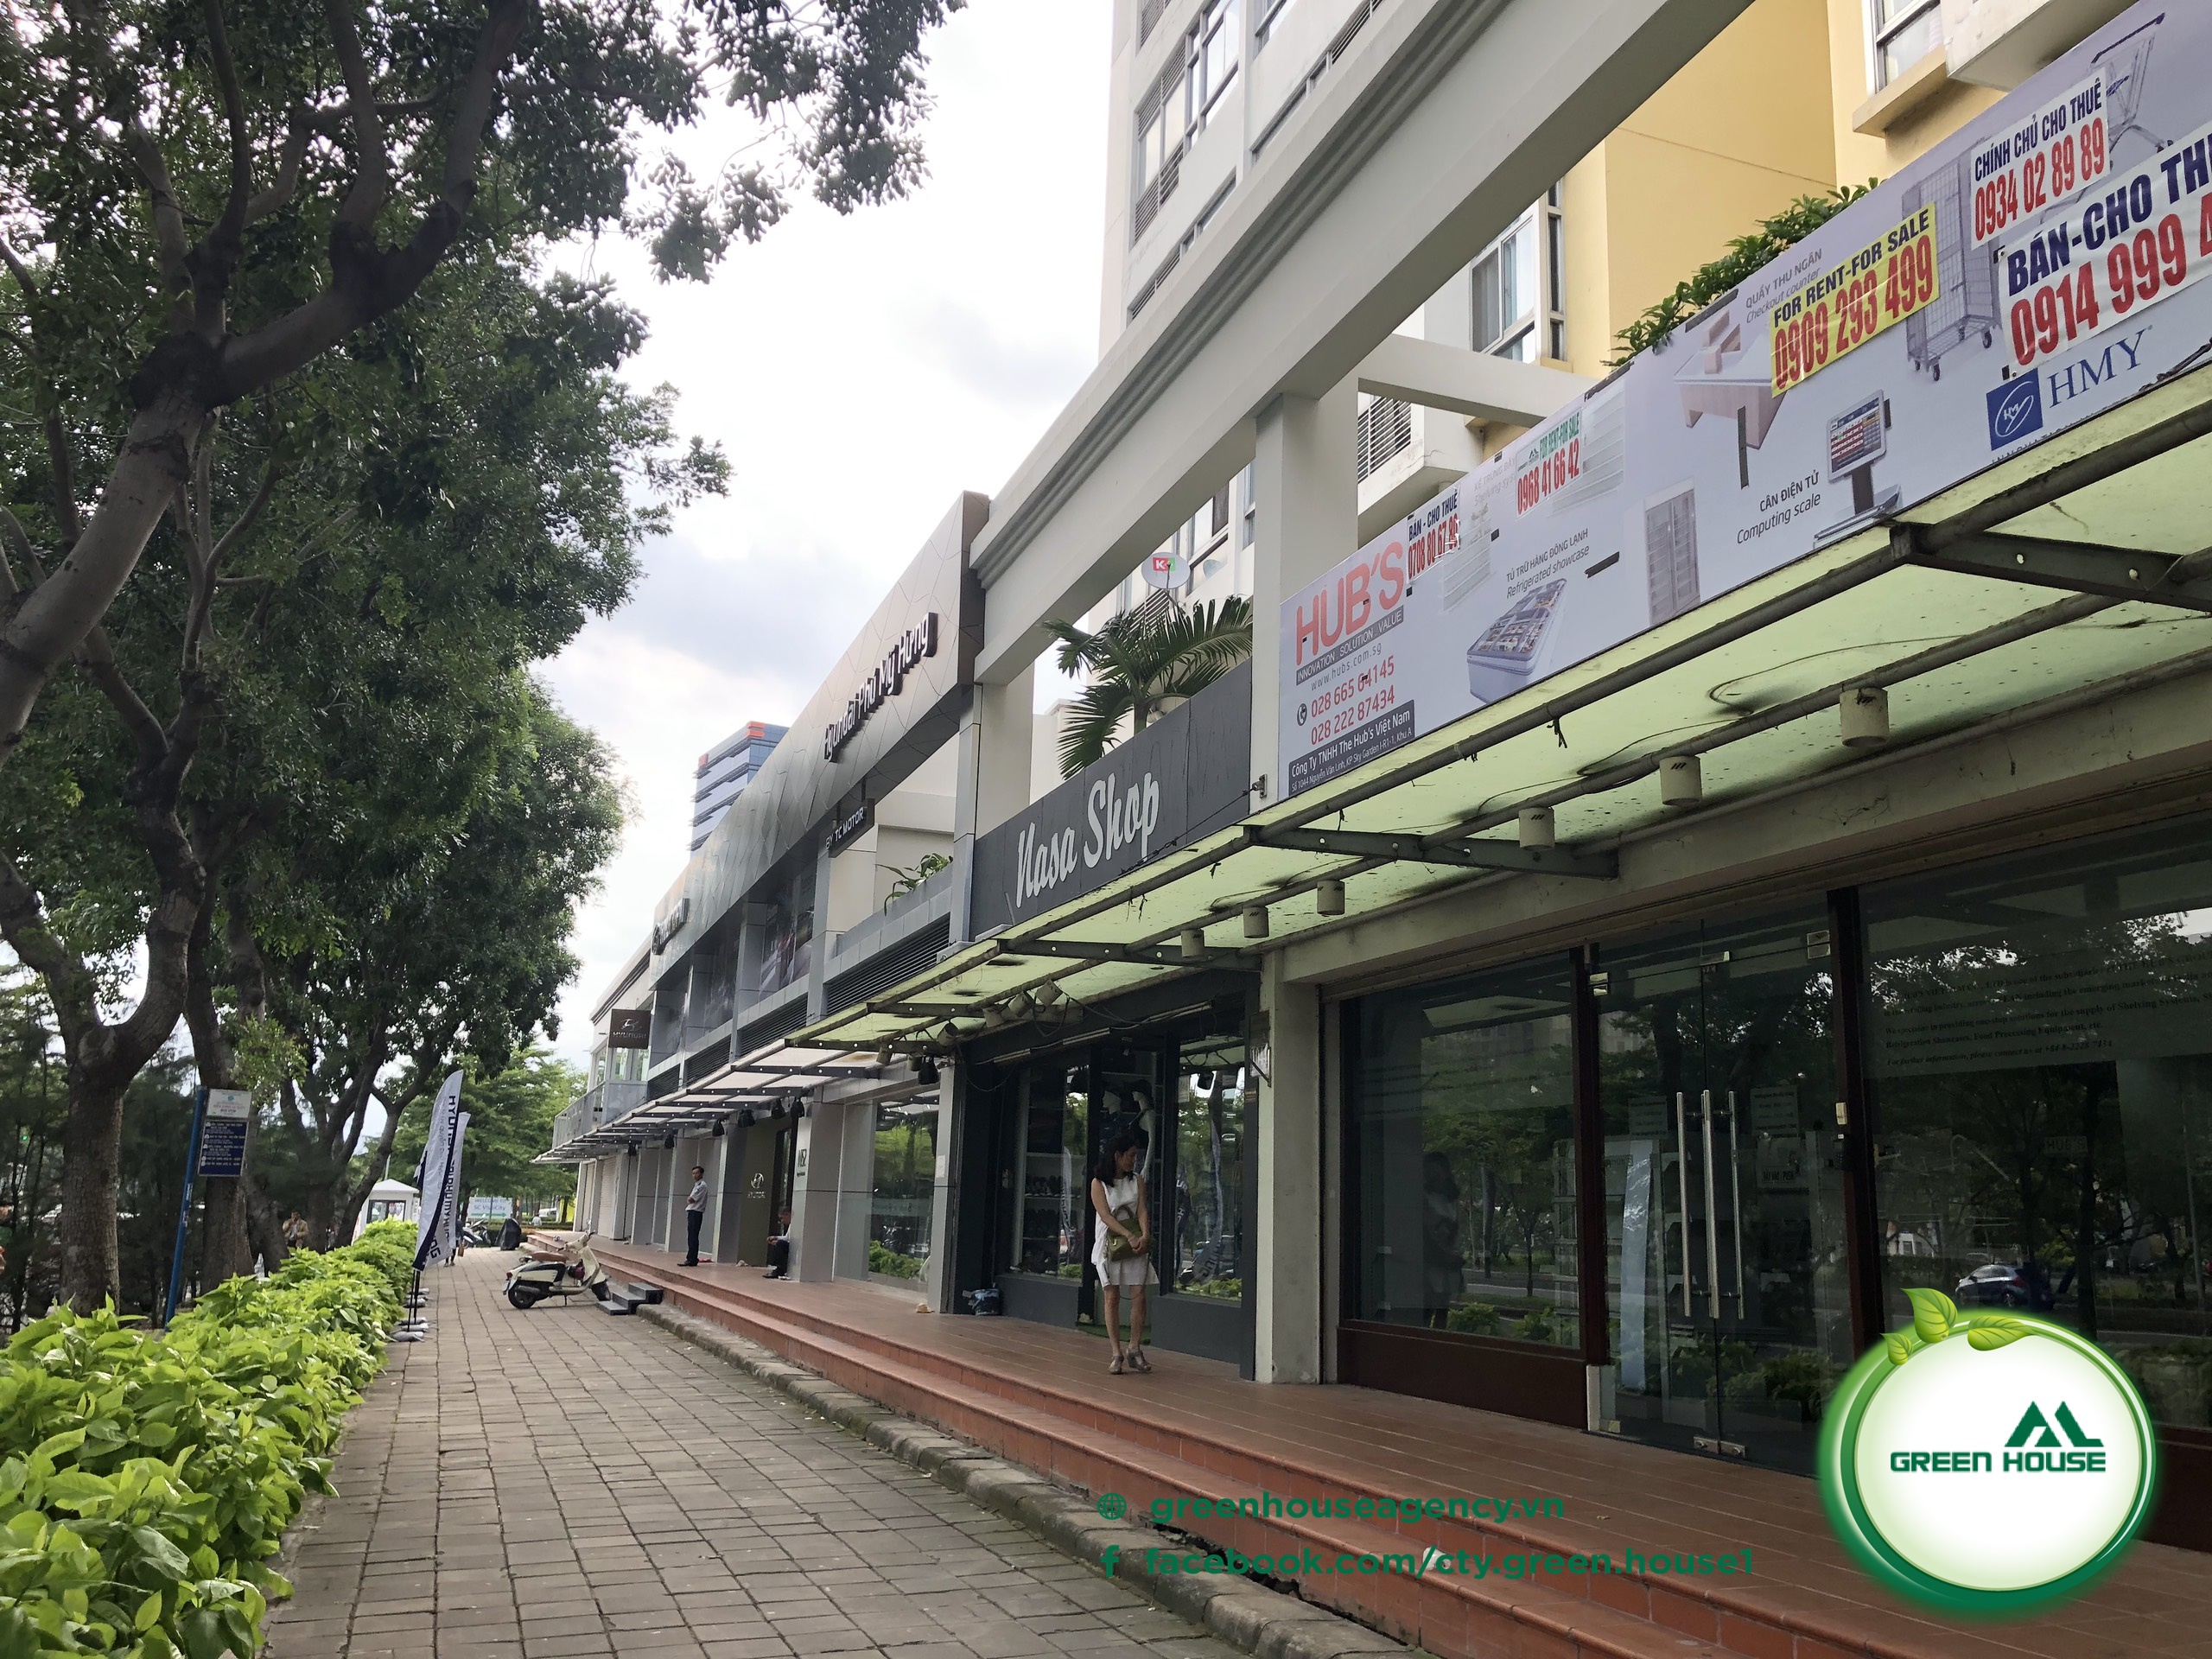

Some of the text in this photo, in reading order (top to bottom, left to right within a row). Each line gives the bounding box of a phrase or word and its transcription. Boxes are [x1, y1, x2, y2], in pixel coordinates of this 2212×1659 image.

[1974, 78, 2102, 181] CHÍNH CHỦ CHO THUÊ
[1975, 117, 2105, 241] 0934 02 89 89
[2160, 132, 2212, 205] TH
[1746, 267, 1821, 324] Checkout counter
[1773, 269, 1792, 290] THU
[1774, 208, 1929, 328] FOR RENT-FOR SALE
[2011, 261, 2100, 366] 0914
[2107, 213, 2188, 314] 999
[1775, 234, 1933, 389] 0909 293 499
[2047, 327, 2148, 409] HMY
[1517, 438, 1580, 514] 0968 41 66 42
[1759, 493, 1779, 512] CÂN
[1780, 480, 1803, 504] ĐIỆN
[1408, 518, 1422, 542] BÁN
[1427, 505, 1440, 528] CHO
[1569, 528, 1588, 547] LẠNH
[1737, 493, 1821, 544] Computing scale
[1408, 536, 1426, 580] 0708
[1427, 528, 1436, 567] 80
[1437, 520, 1447, 558] 67
[1506, 545, 1590, 599] Refrigerated showcase
[1296, 541, 1405, 665] HUB'S
[1297, 609, 1402, 681] INNOVATION SOLUTION VALUE
[1311, 642, 1382, 691] www.hubs.com.sg
[1311, 691, 1332, 718] 028
[1333, 677, 1355, 705] 665
[1311, 684, 1395, 746] 028 222 87434
[1292, 710, 1411, 778] Công Ty TNHH The Hub's Việt Nam
[1353, 751, 1362, 763] Sky
[1362, 744, 1379, 760] Garden
[842, 806, 864, 836] MOTOR
[1016, 772, 1160, 908] Nasa Shop
[2075, 1005, 2104, 1017] supply
[2107, 1003, 2115, 1012] of
[2117, 1001, 2157, 1010] Shelving
